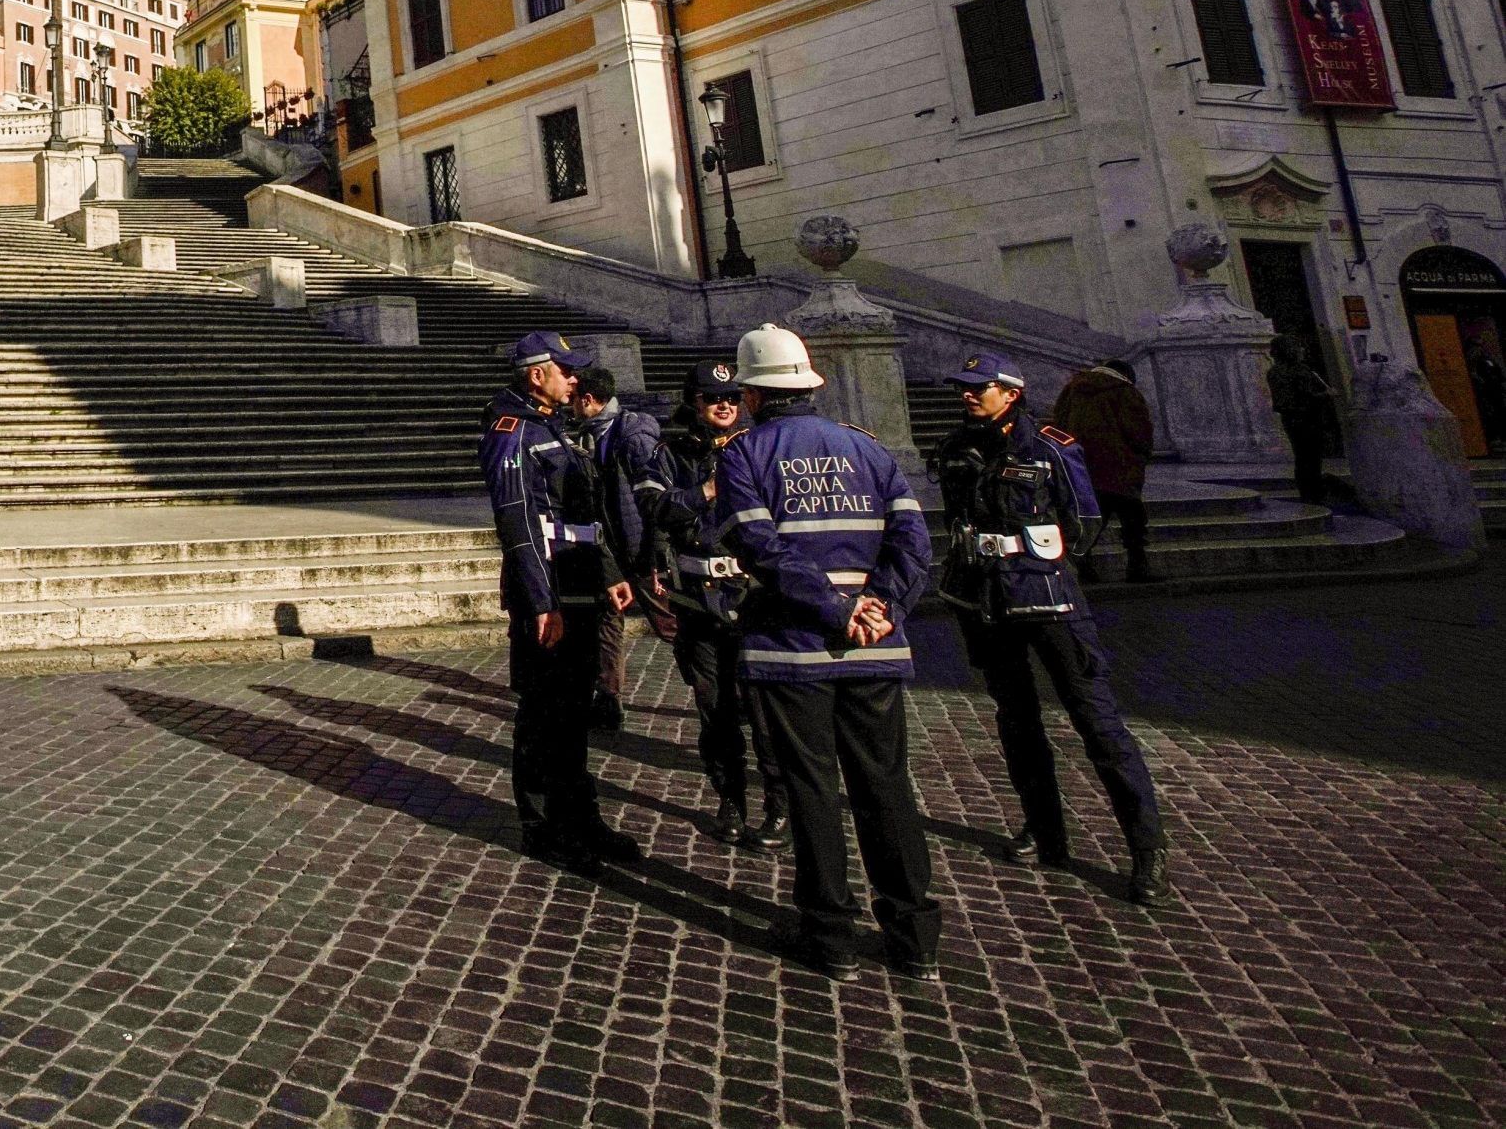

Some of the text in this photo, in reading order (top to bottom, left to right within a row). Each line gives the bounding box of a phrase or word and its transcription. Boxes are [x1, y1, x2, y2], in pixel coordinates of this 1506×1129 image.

[1357, 24, 1380, 90] MUSEUM
[1406, 271, 1444, 282] ACQUA
[1458, 272, 1496, 283] PARMA
[779, 456, 855, 476] POLIZIA
[784, 475, 846, 495] ROMA
[784, 495, 874, 514] CAPITALE
